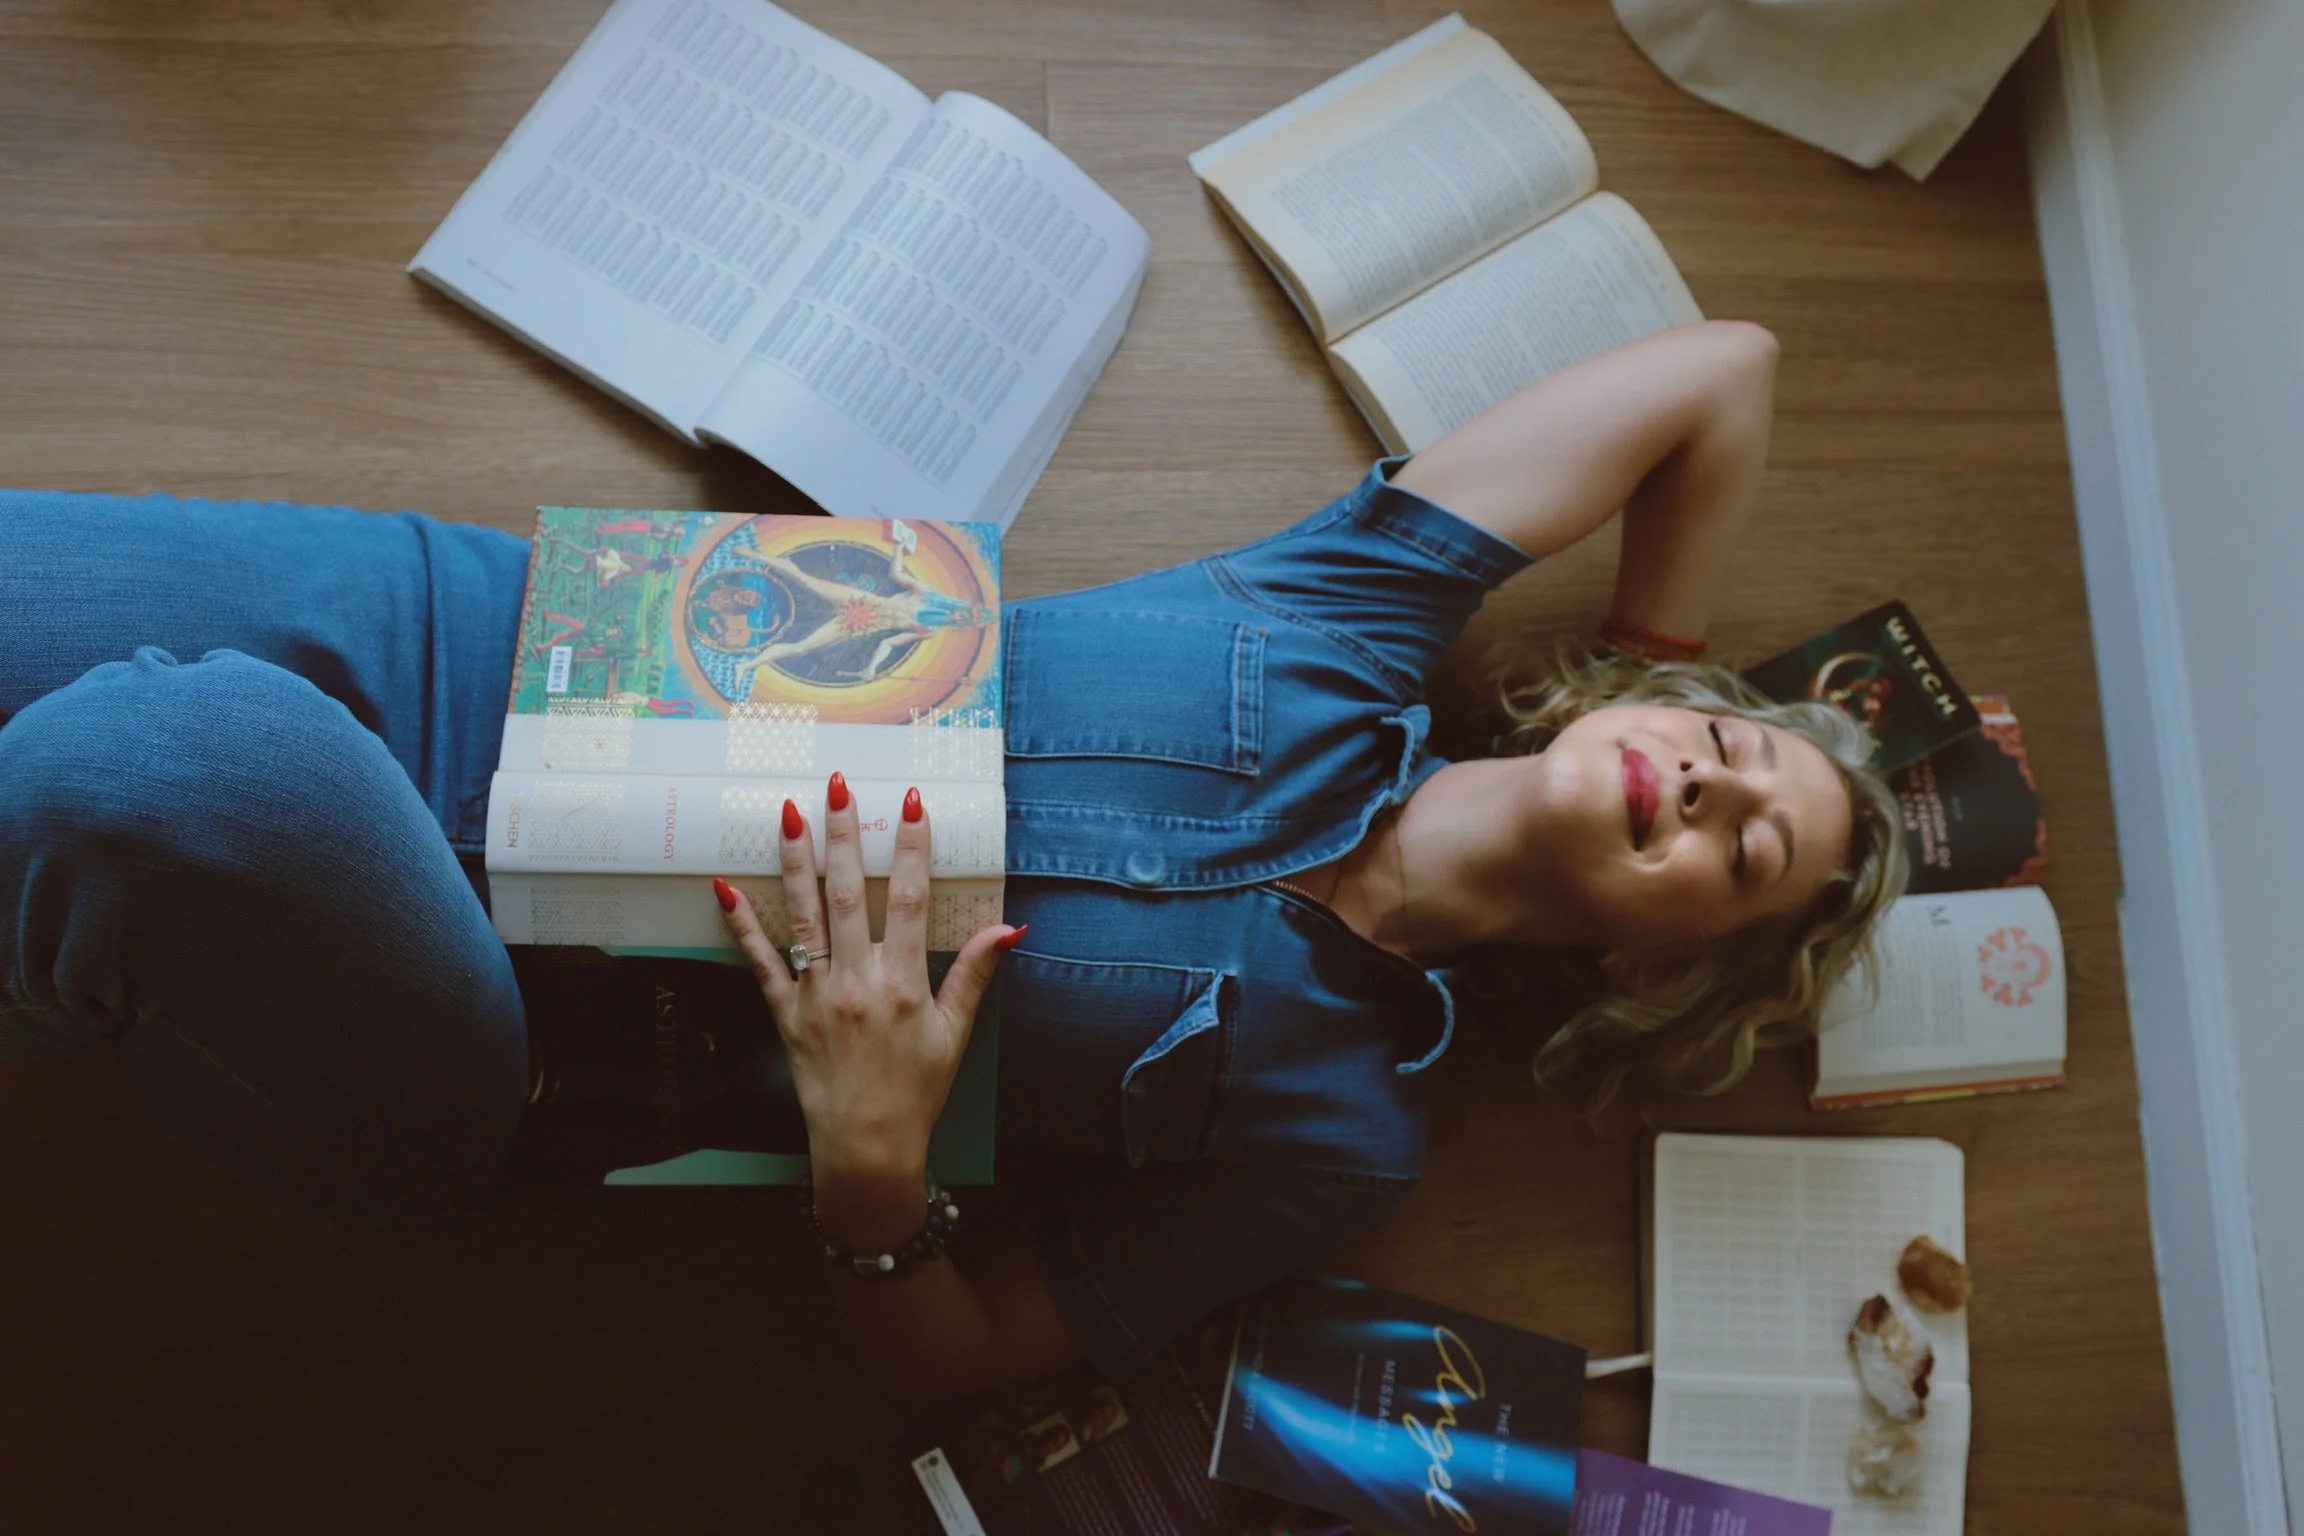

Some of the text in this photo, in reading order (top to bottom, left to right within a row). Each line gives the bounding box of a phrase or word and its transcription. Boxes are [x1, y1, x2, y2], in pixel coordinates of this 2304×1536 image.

[1886, 617, 1957, 714] WITCH
[507, 791, 523, 848] TASCHEN
[664, 787, 678, 862] ASTROLOGY
[1374, 1358, 1396, 1454] MESSAGES
